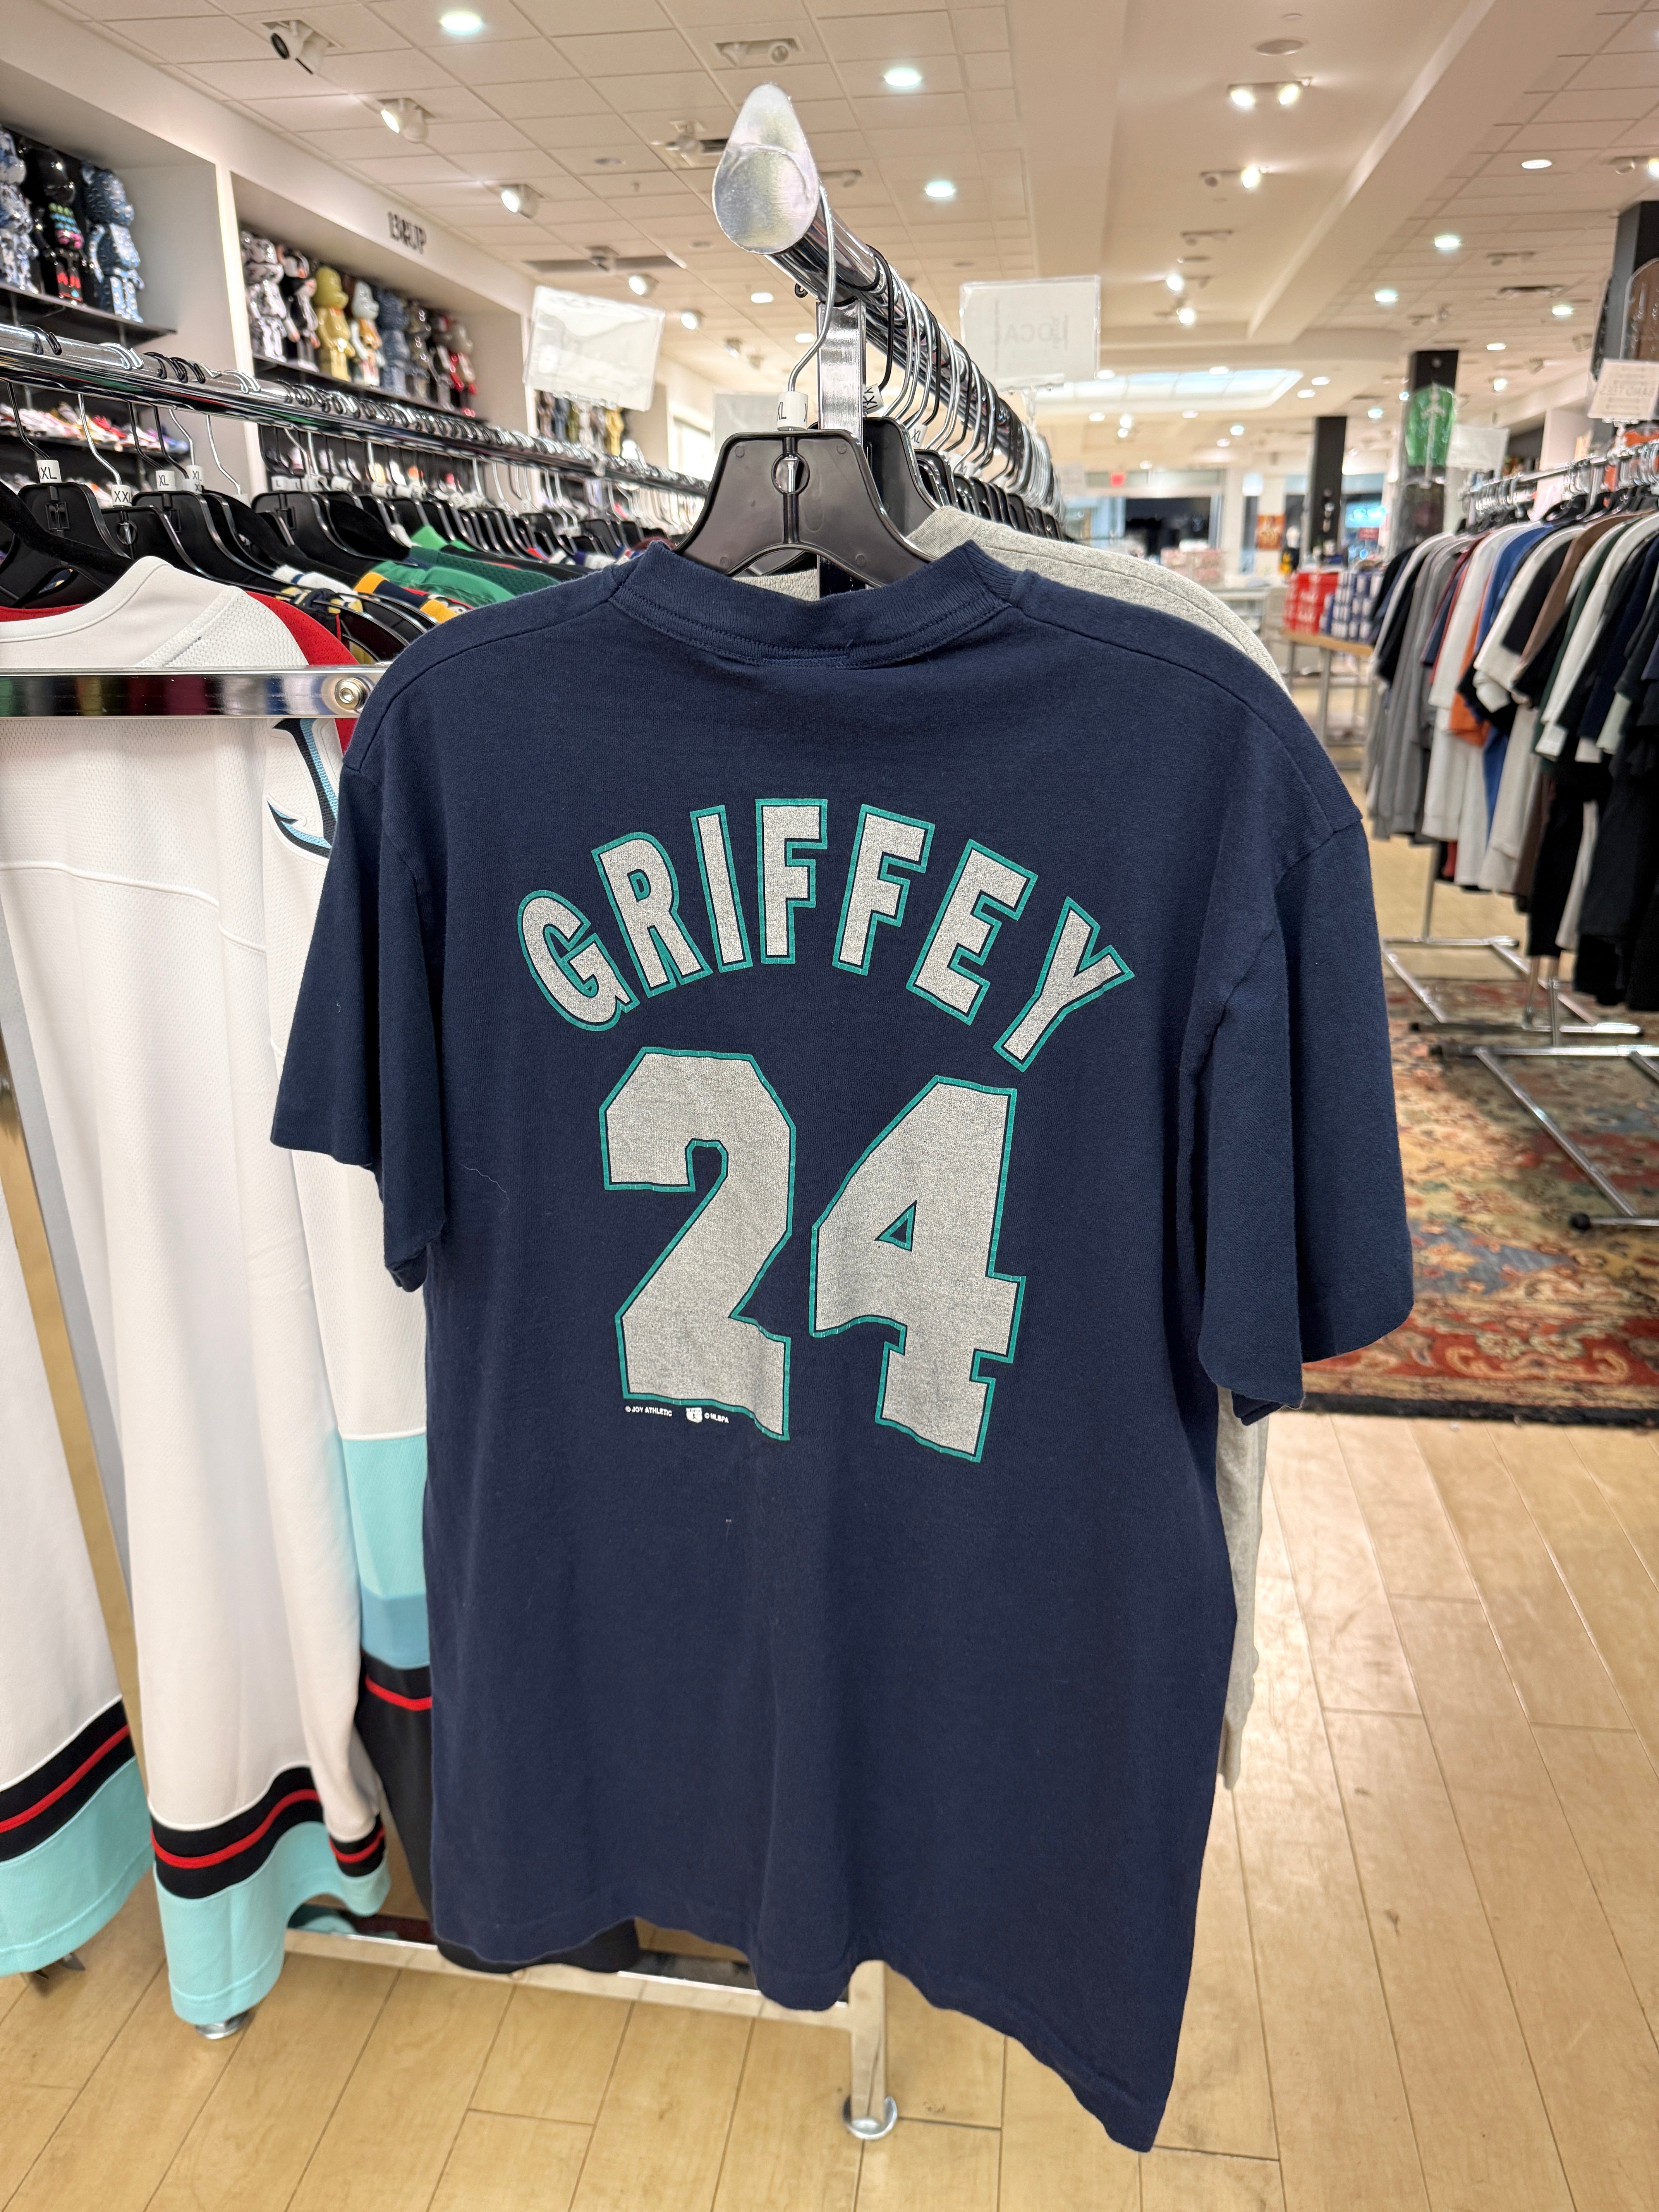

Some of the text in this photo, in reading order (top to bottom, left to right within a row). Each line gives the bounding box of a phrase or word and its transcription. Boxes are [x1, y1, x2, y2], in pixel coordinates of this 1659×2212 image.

[912, 429, 921, 443] XL
[39, 467, 57, 479] XL
[159, 475, 169, 486] XL
[518, 799, 1135, 1072] GRIFFEY
[599, 1047, 1026, 1462] 24
[645, 1407, 672, 1417] ATHLETIC
[710, 1413, 729, 1424] MLBPA
